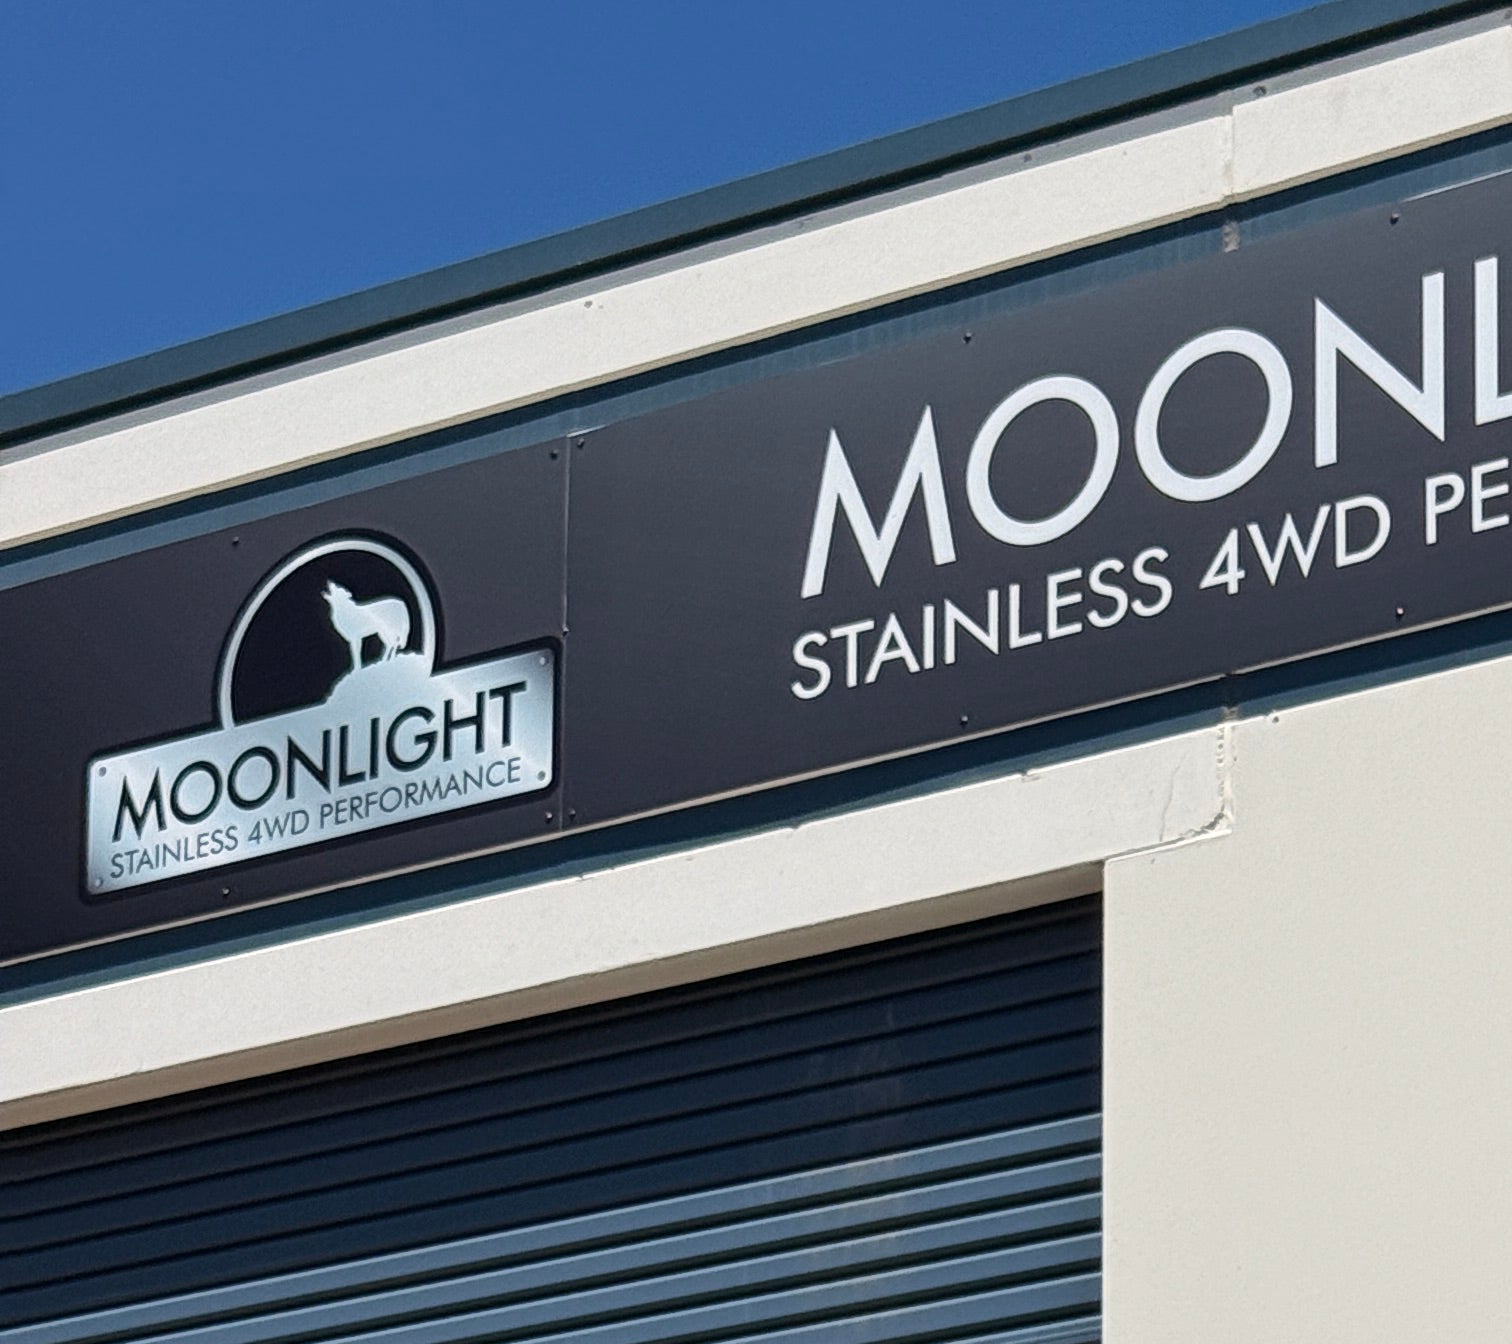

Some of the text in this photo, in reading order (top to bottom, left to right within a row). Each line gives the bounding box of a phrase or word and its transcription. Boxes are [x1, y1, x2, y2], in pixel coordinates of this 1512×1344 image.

[790, 547, 1173, 701] STAINLESS
[1200, 493, 1392, 598] 4WD
[110, 757, 522, 879] STAINLESS 4WD PERFORMANCE
[111, 680, 527, 843] MOONLIGHT
